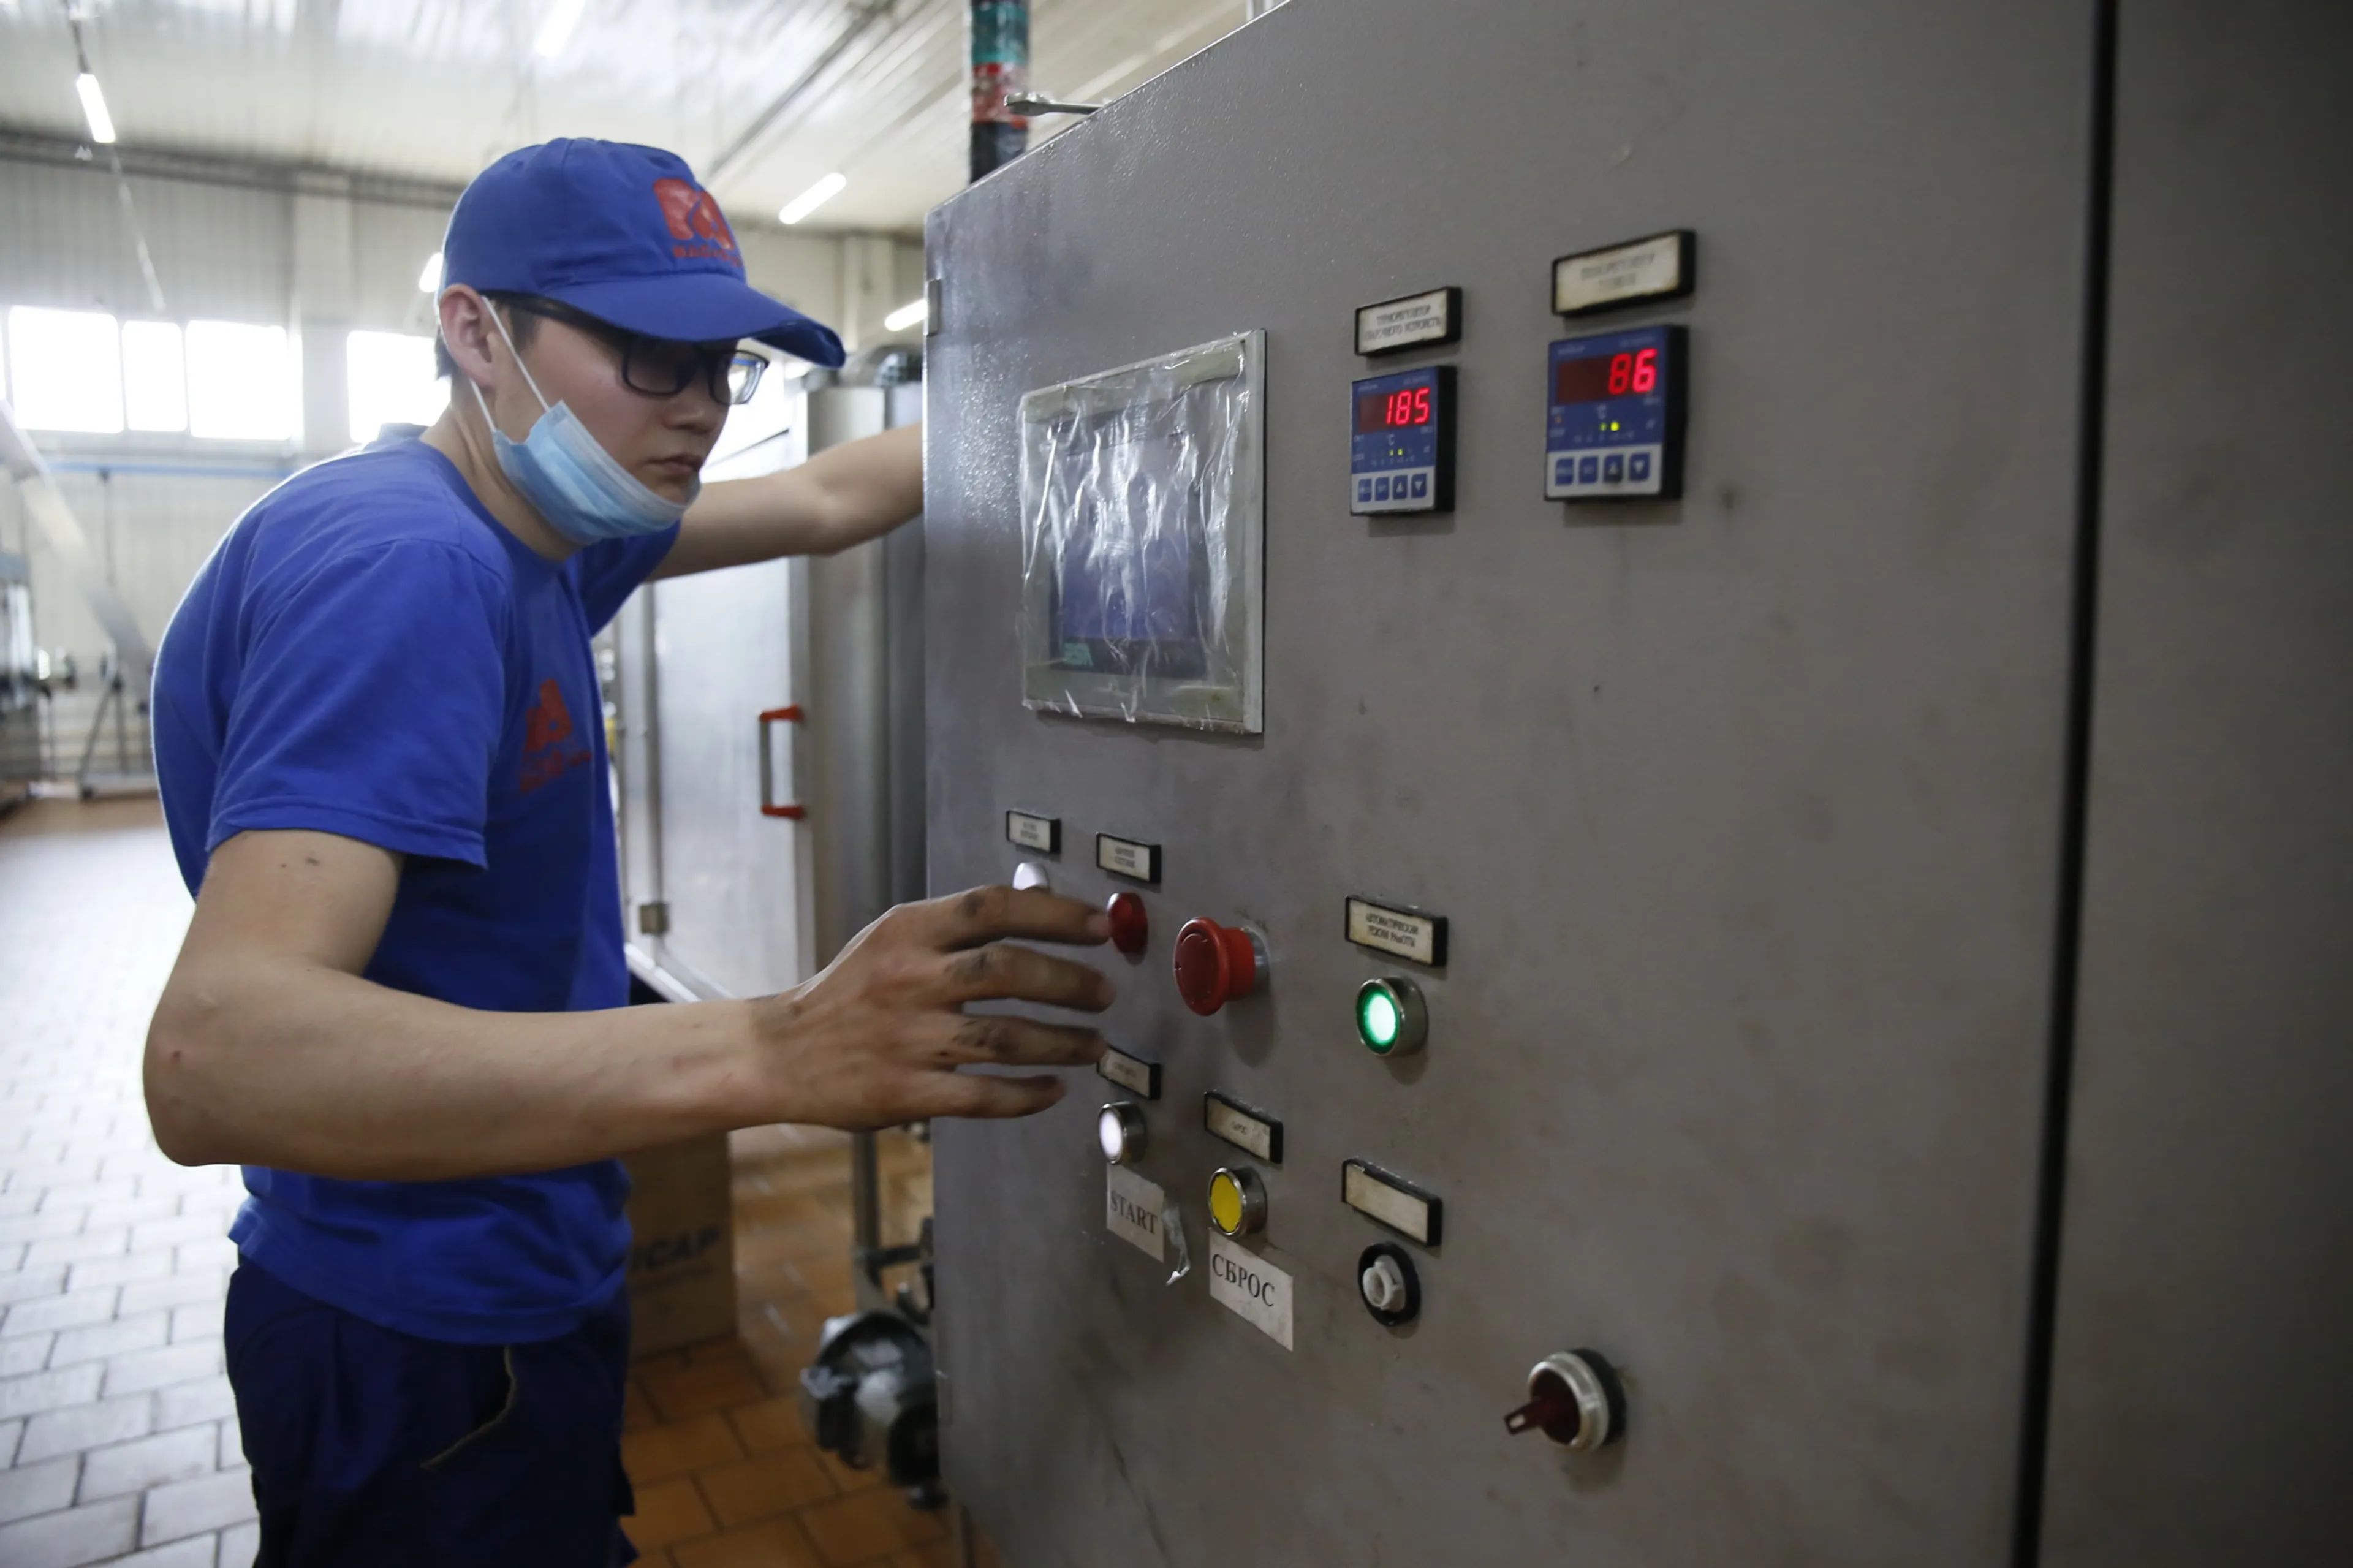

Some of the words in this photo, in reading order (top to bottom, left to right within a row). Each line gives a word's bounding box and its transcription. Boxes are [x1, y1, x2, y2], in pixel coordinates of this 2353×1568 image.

[1608, 348, 1657, 394] 86
[1385, 387, 1430, 425] 185
[1110, 1190, 1158, 1234] START
[1213, 1254, 1275, 1307] СБРОС
